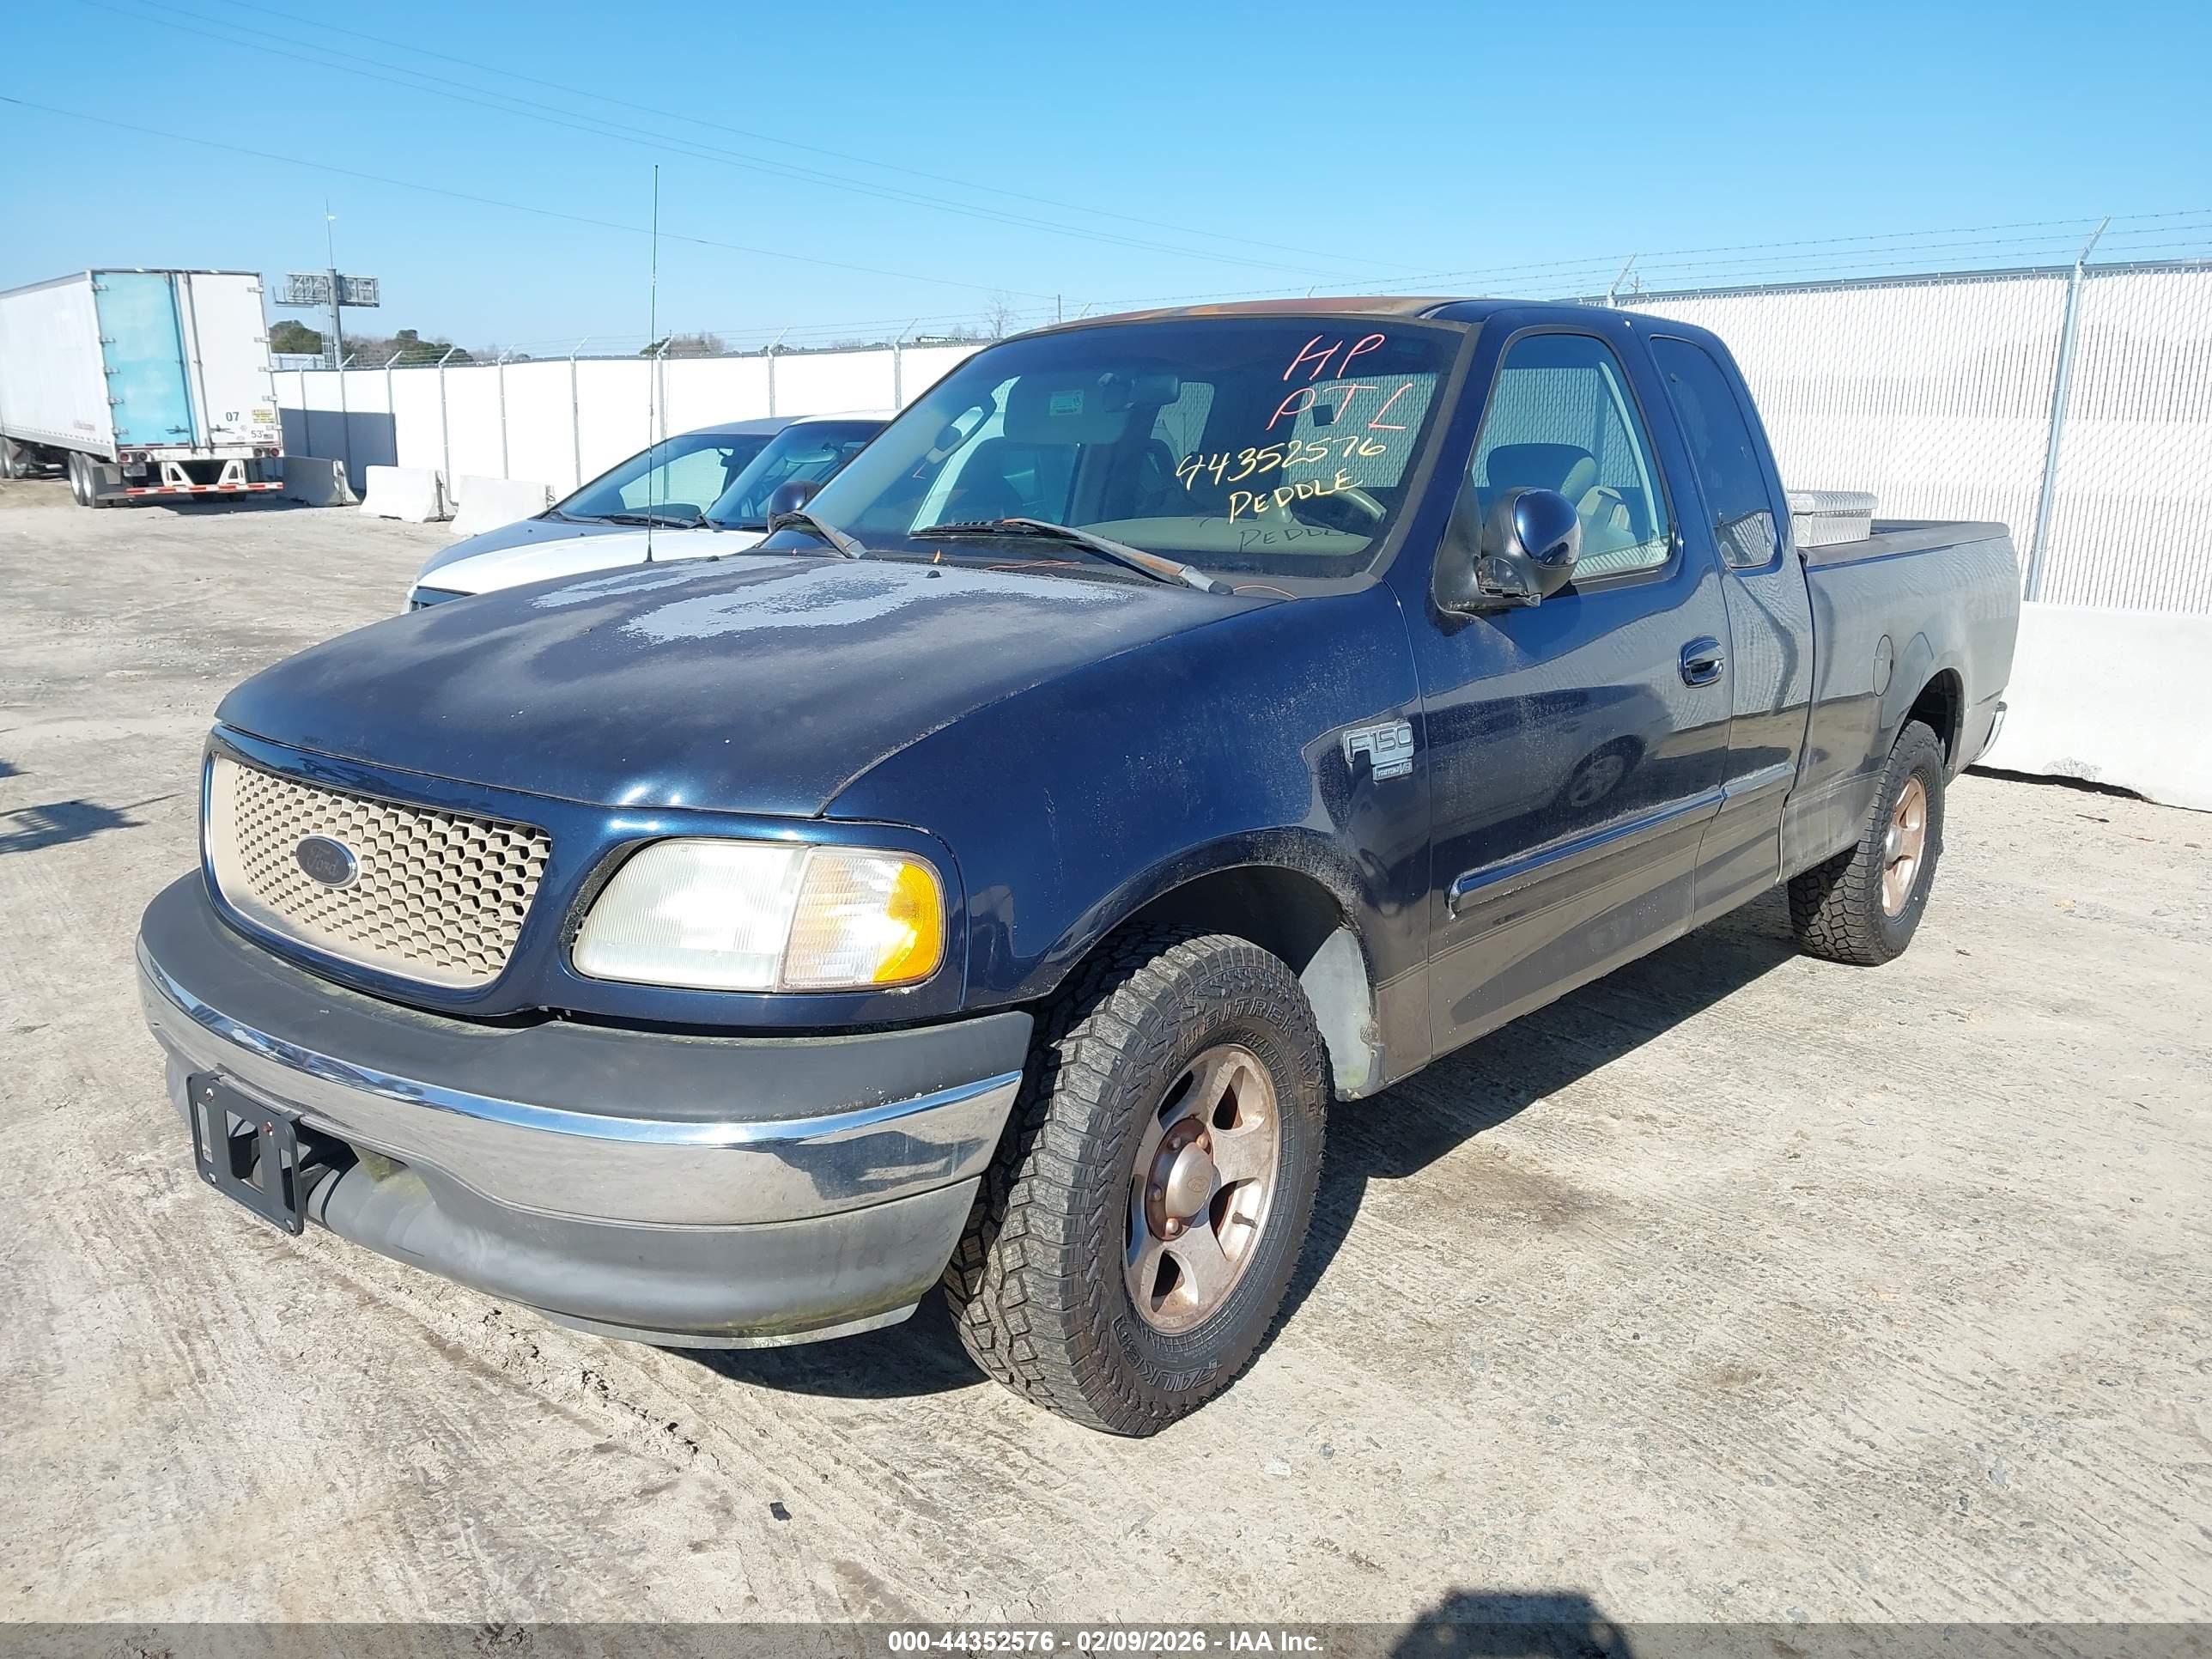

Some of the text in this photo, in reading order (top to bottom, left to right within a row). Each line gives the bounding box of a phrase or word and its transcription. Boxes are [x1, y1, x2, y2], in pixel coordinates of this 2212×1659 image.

[1283, 333, 1385, 381] HP
[225, 411, 240, 422] 07
[1175, 435, 1387, 492] 44352576
[1228, 468, 1364, 525] PEDDLE
[1160, 996, 1295, 1079] RUBITREK
[1112, 1314, 1224, 1393] FALKEN
